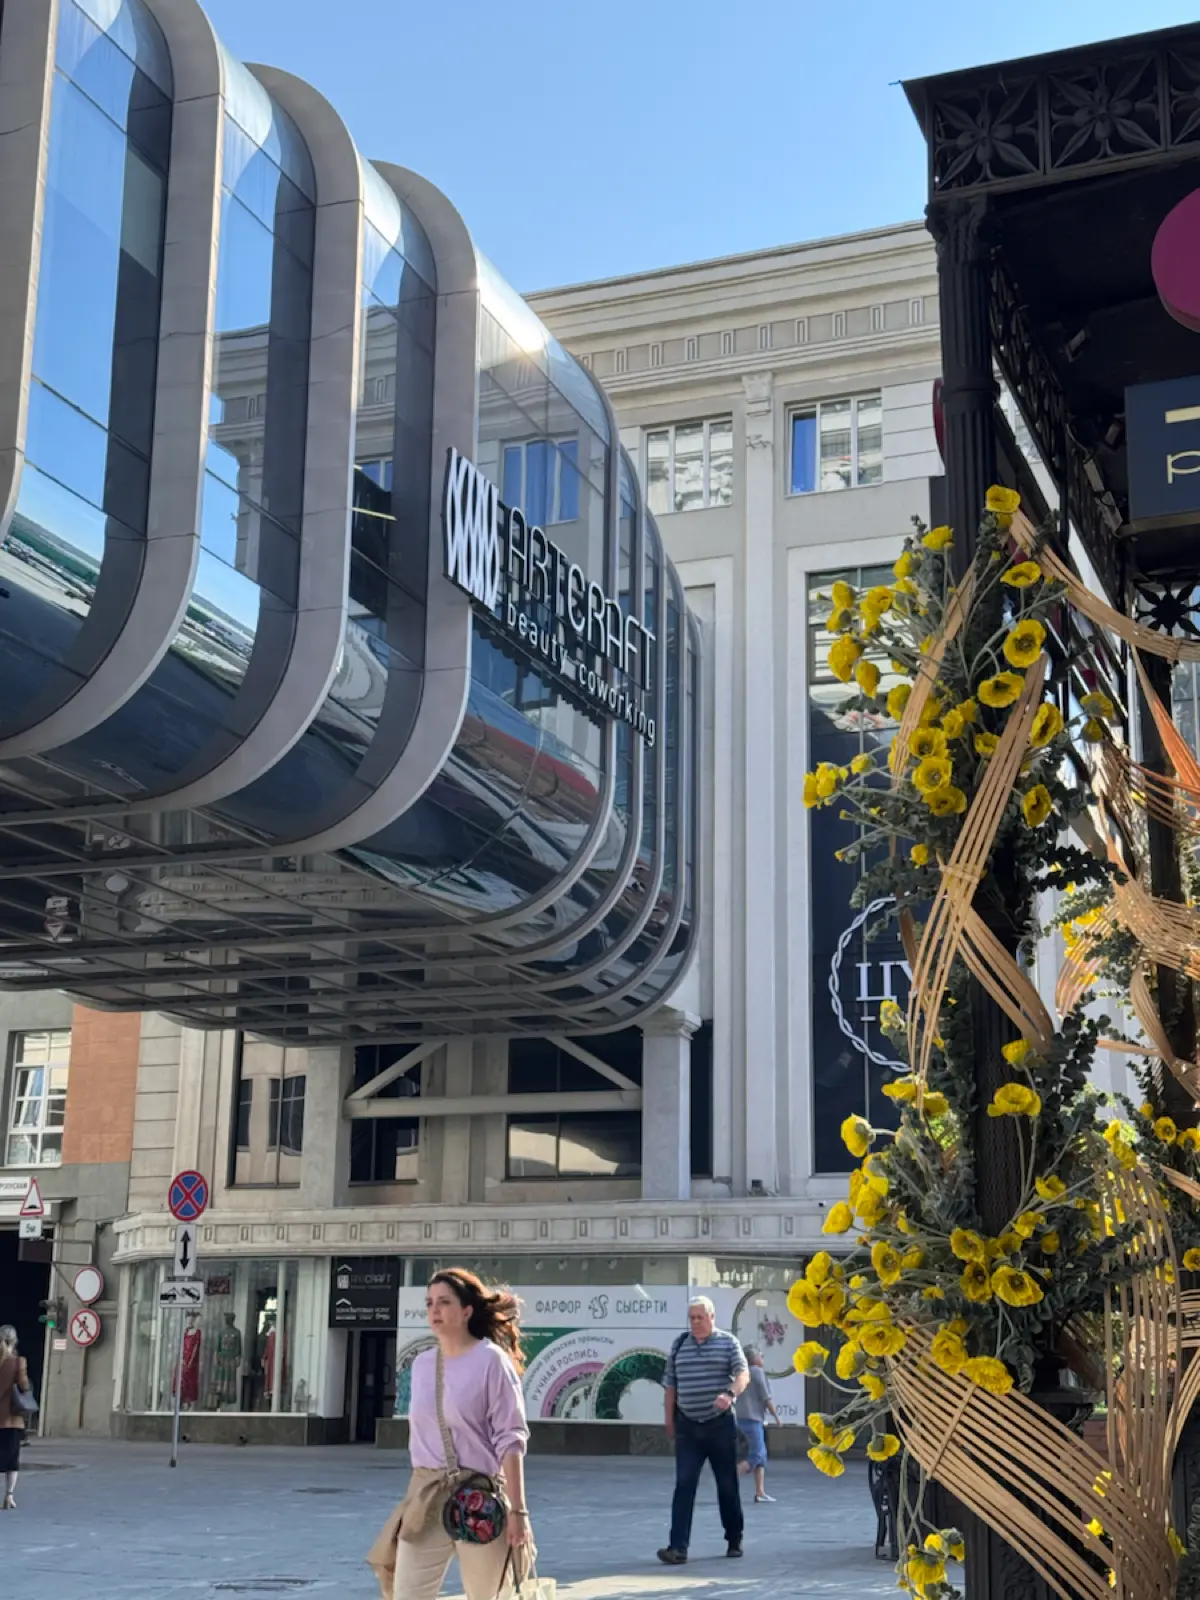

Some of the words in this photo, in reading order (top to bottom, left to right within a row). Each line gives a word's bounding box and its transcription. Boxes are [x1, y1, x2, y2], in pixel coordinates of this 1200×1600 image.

[508, 506, 656, 690] ARTCRAFT
[507, 594, 568, 674] beauty
[580, 662, 656, 746] coworking
[535, 1300, 581, 1314] ФАРФОР
[615, 1300, 668, 1314] СЫСЕРТИ
[531, 1365, 557, 1401] РУЧНАЯ
[557, 1348, 598, 1369] РОСПИСЬ
[773, 1404, 798, 1416] ОТЫ
